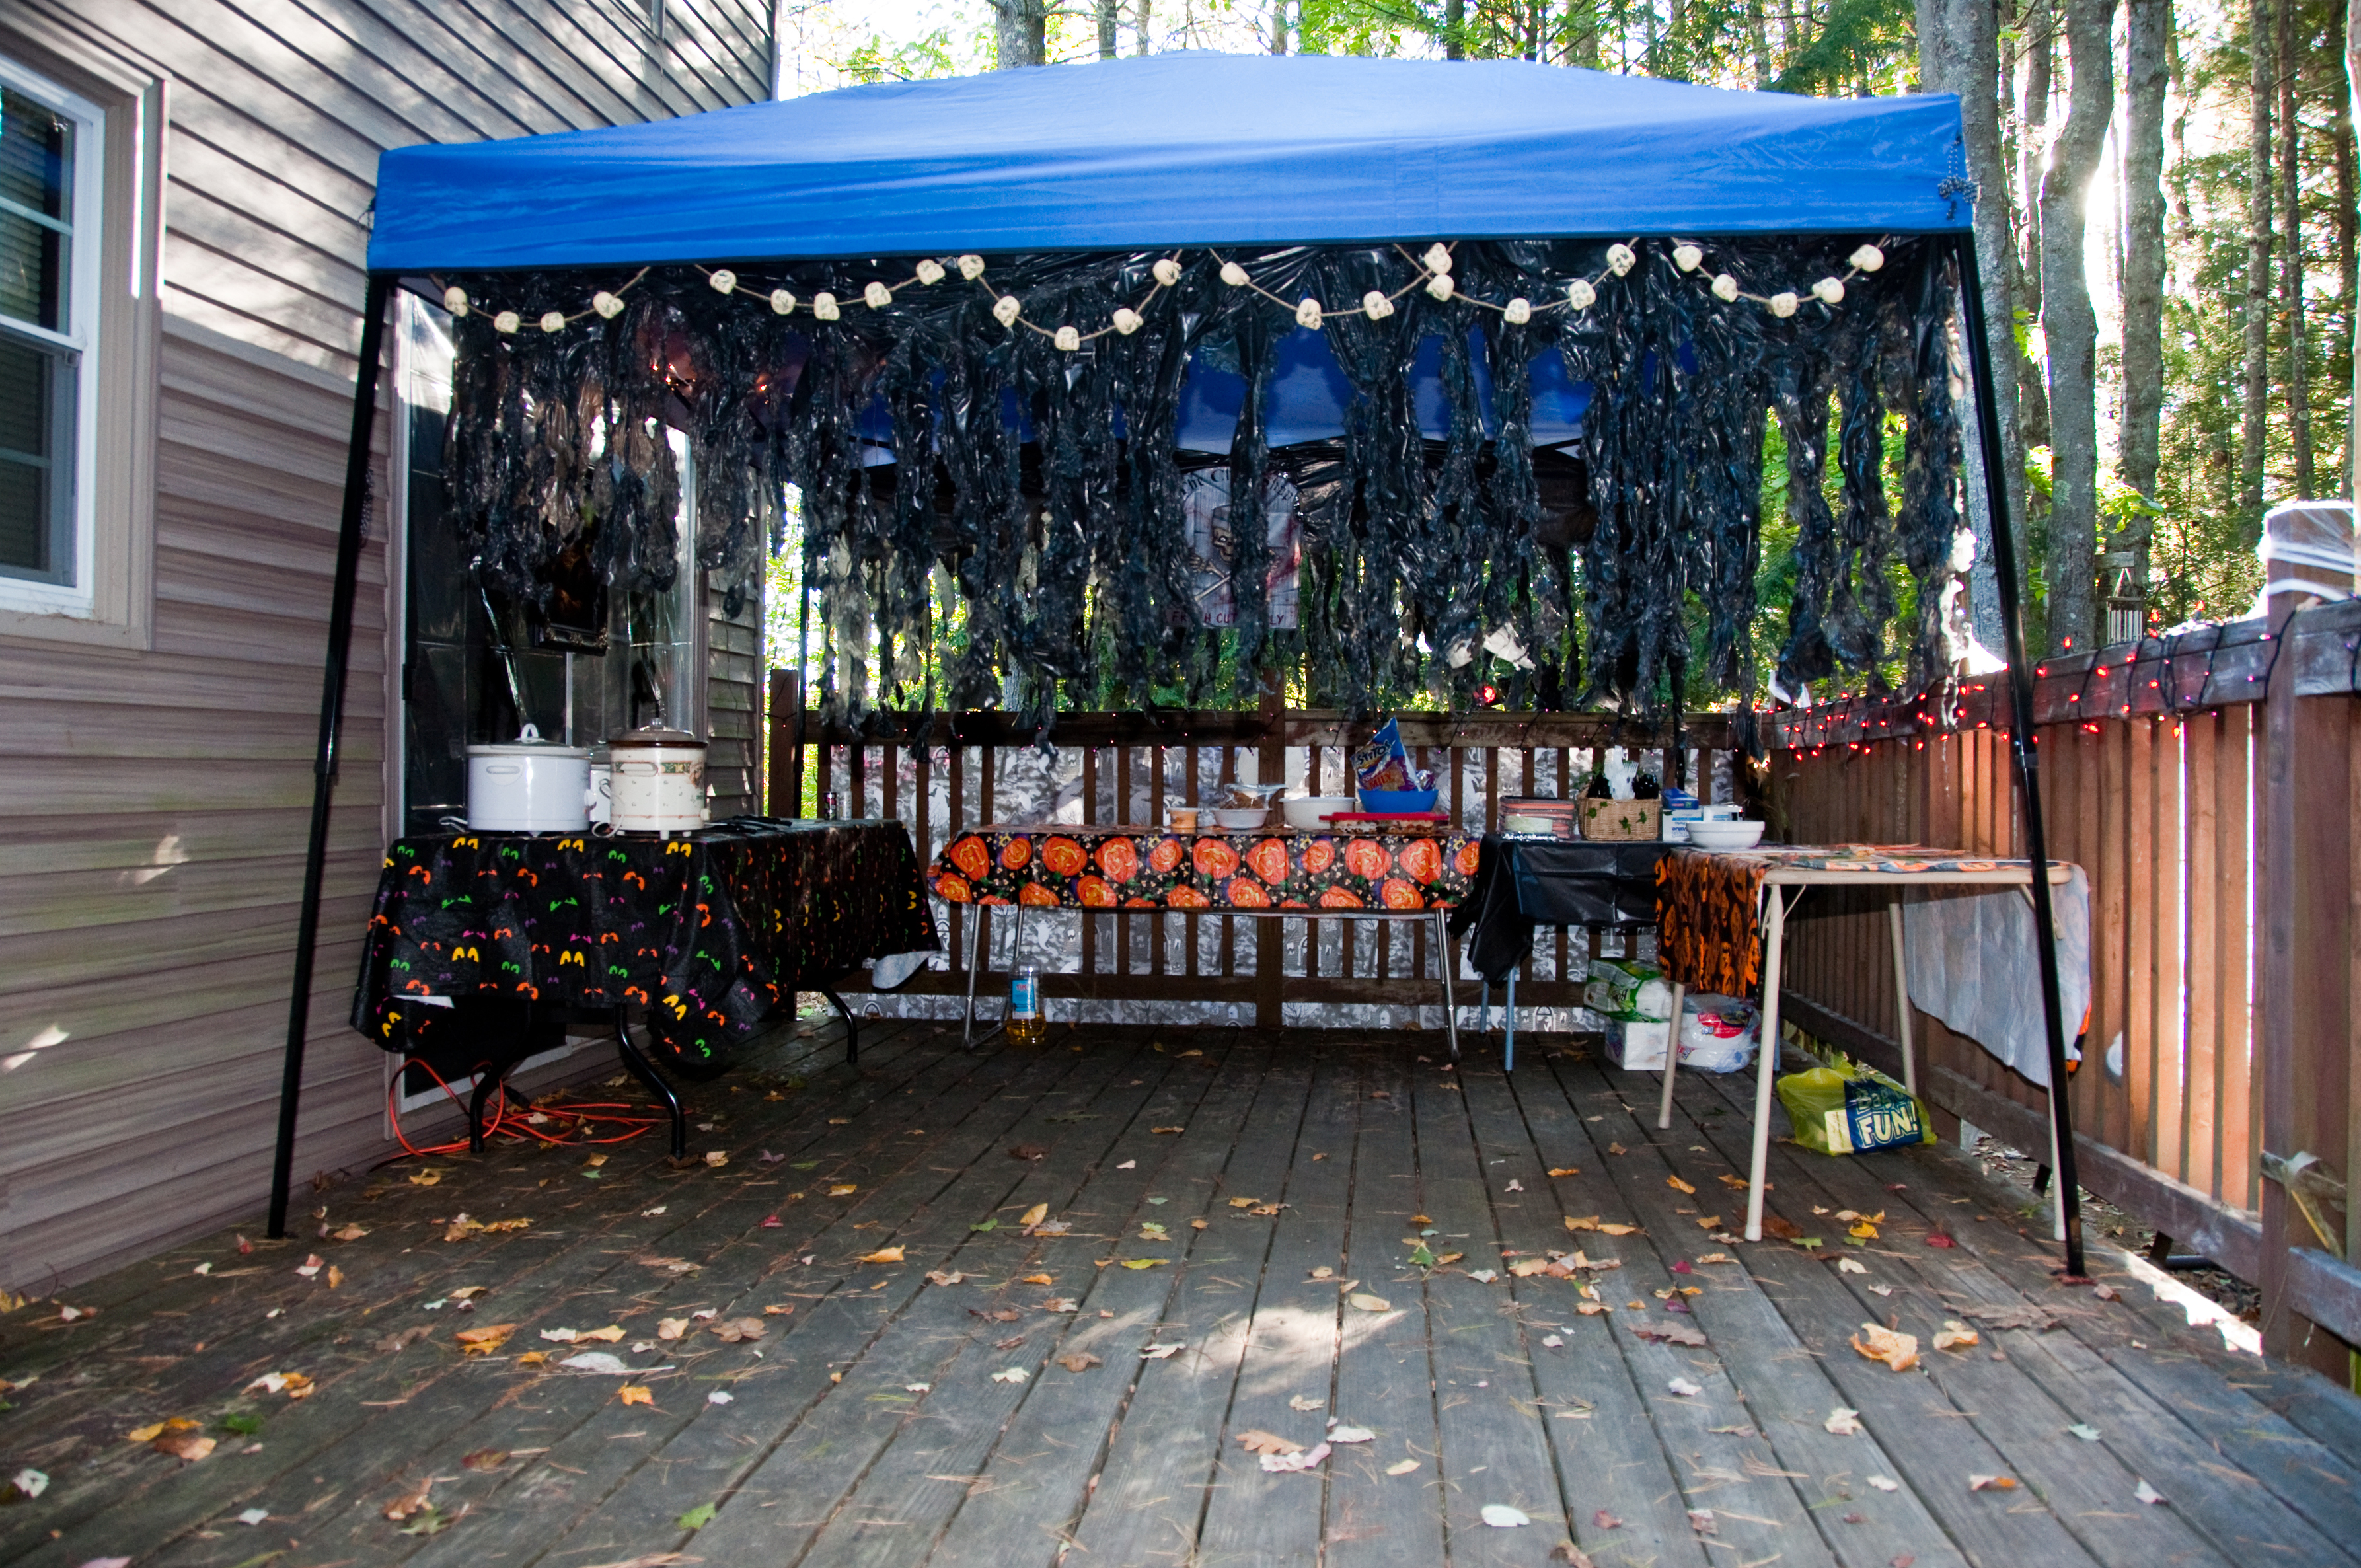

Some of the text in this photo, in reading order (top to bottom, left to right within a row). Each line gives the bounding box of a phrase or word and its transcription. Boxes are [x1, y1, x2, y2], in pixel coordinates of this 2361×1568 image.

[1172, 611, 1238, 624] FRH CUT
[1855, 1088, 1893, 1113] Bag
[1857, 1101, 1918, 1146] FUN!
